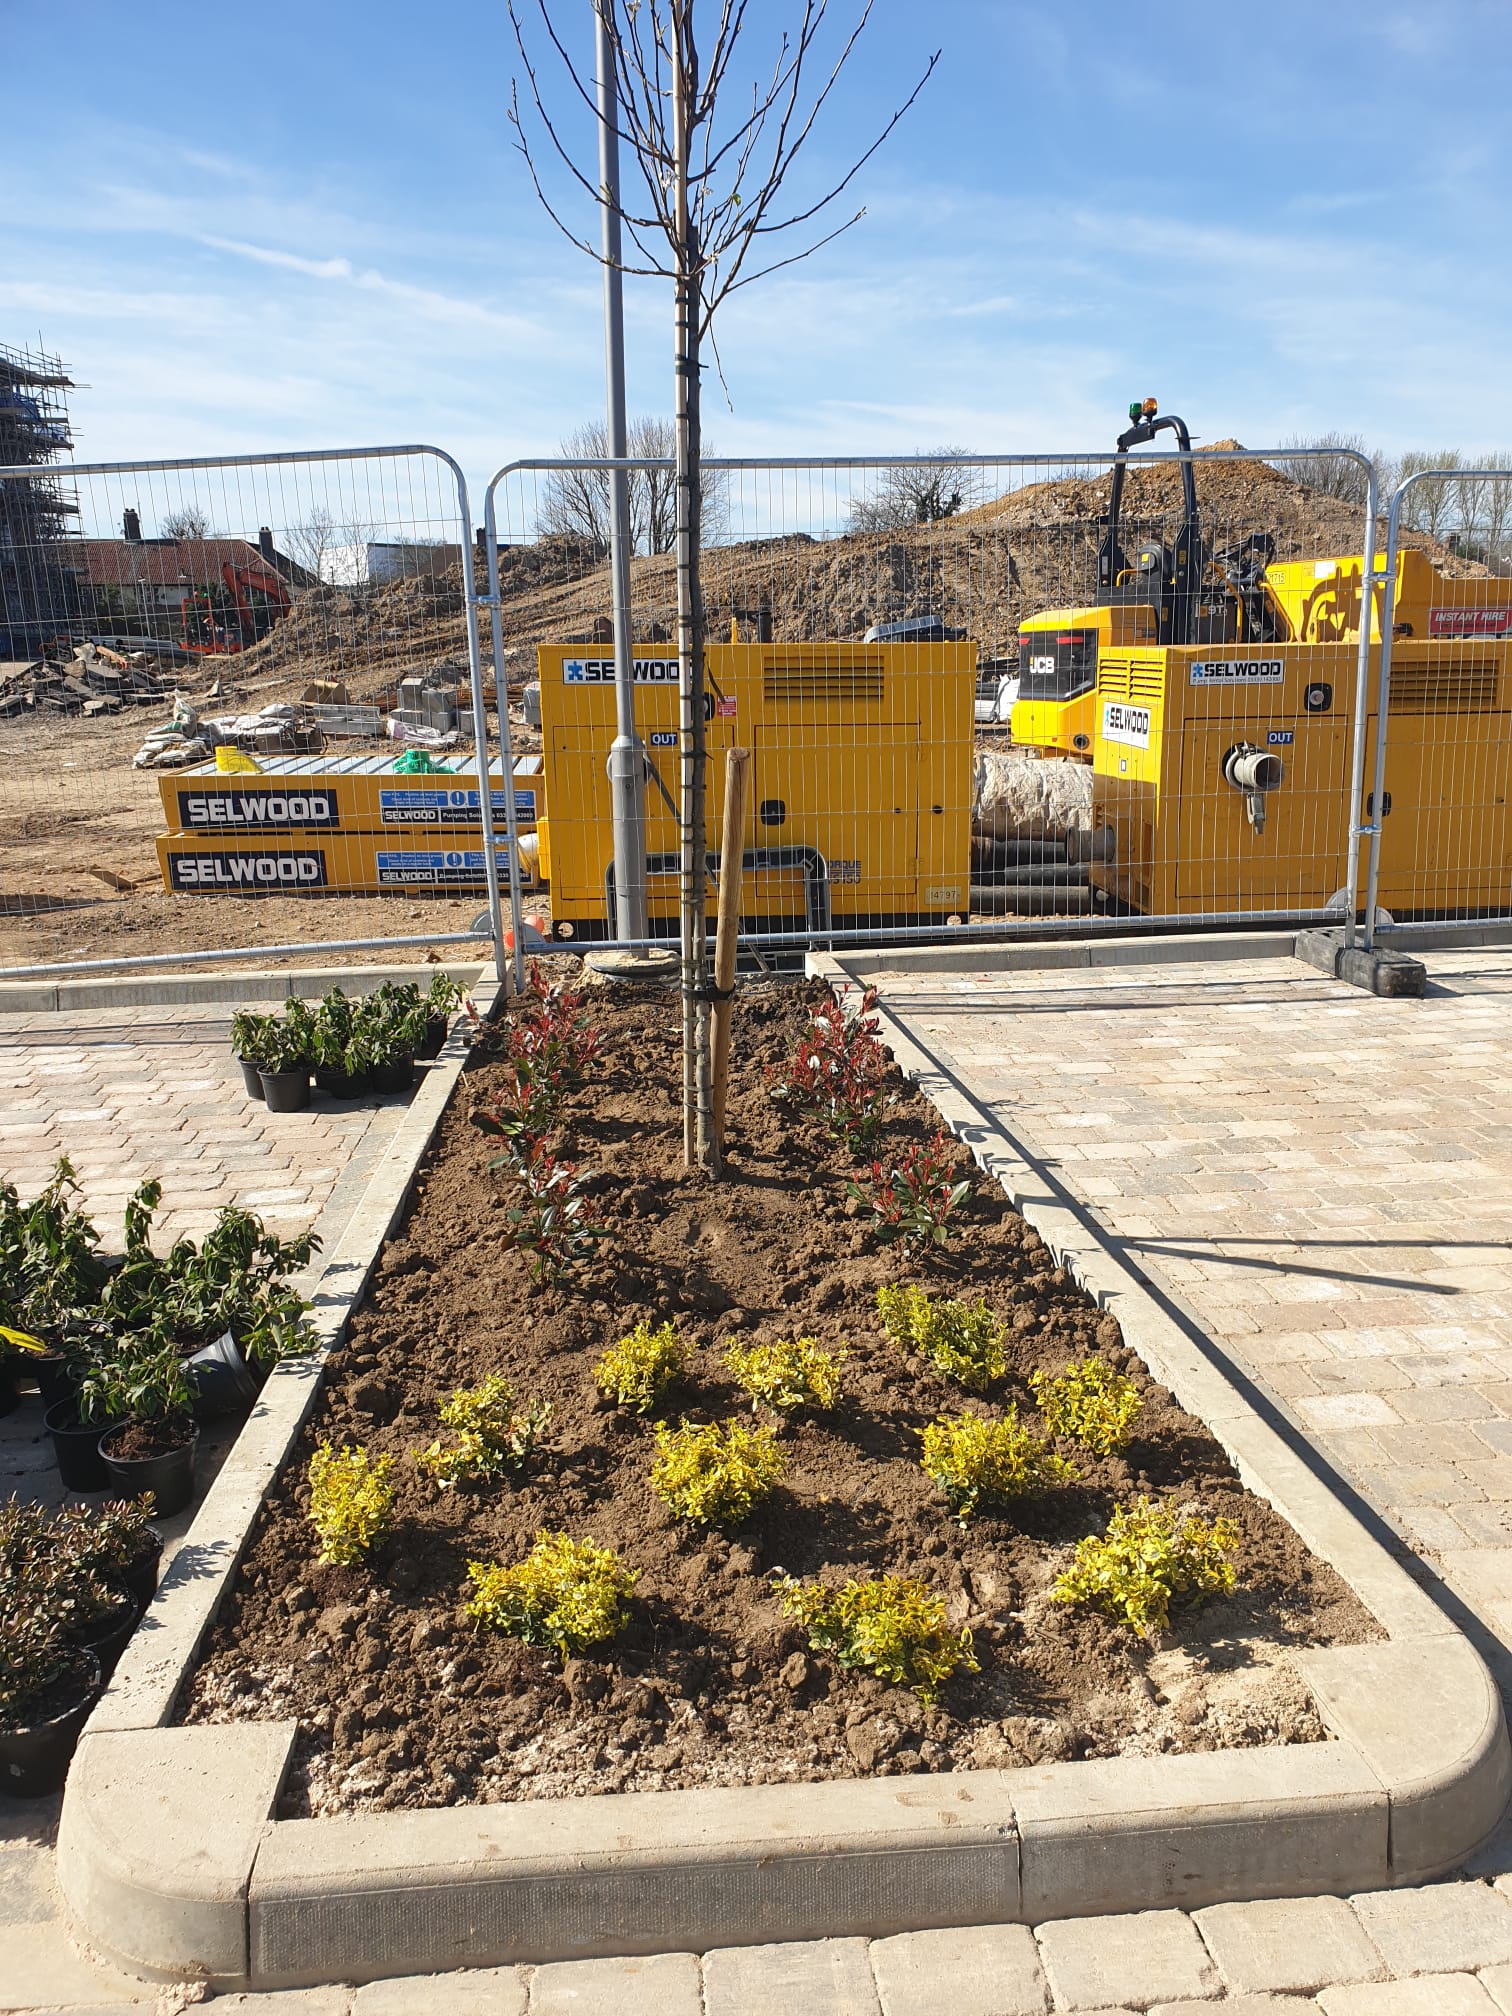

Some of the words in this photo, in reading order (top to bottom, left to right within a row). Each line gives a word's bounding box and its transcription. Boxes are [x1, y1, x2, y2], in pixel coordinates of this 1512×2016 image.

[1435, 612, 1479, 621] INSTANT
[1481, 611, 1506, 620] HIRE
[585, 661, 693, 681] SEWOO
[1029, 656, 1055, 674] JCB
[1204, 661, 1281, 677] SELWOOD
[1110, 706, 1149, 735] SELWOOD
[652, 734, 677, 744] OUT
[1268, 733, 1293, 742] OUT
[187, 797, 330, 822] SELWOOD
[384, 810, 436, 820] SELWOOD
[177, 857, 319, 883] SELWOOD
[382, 871, 432, 881] SELWOOD
